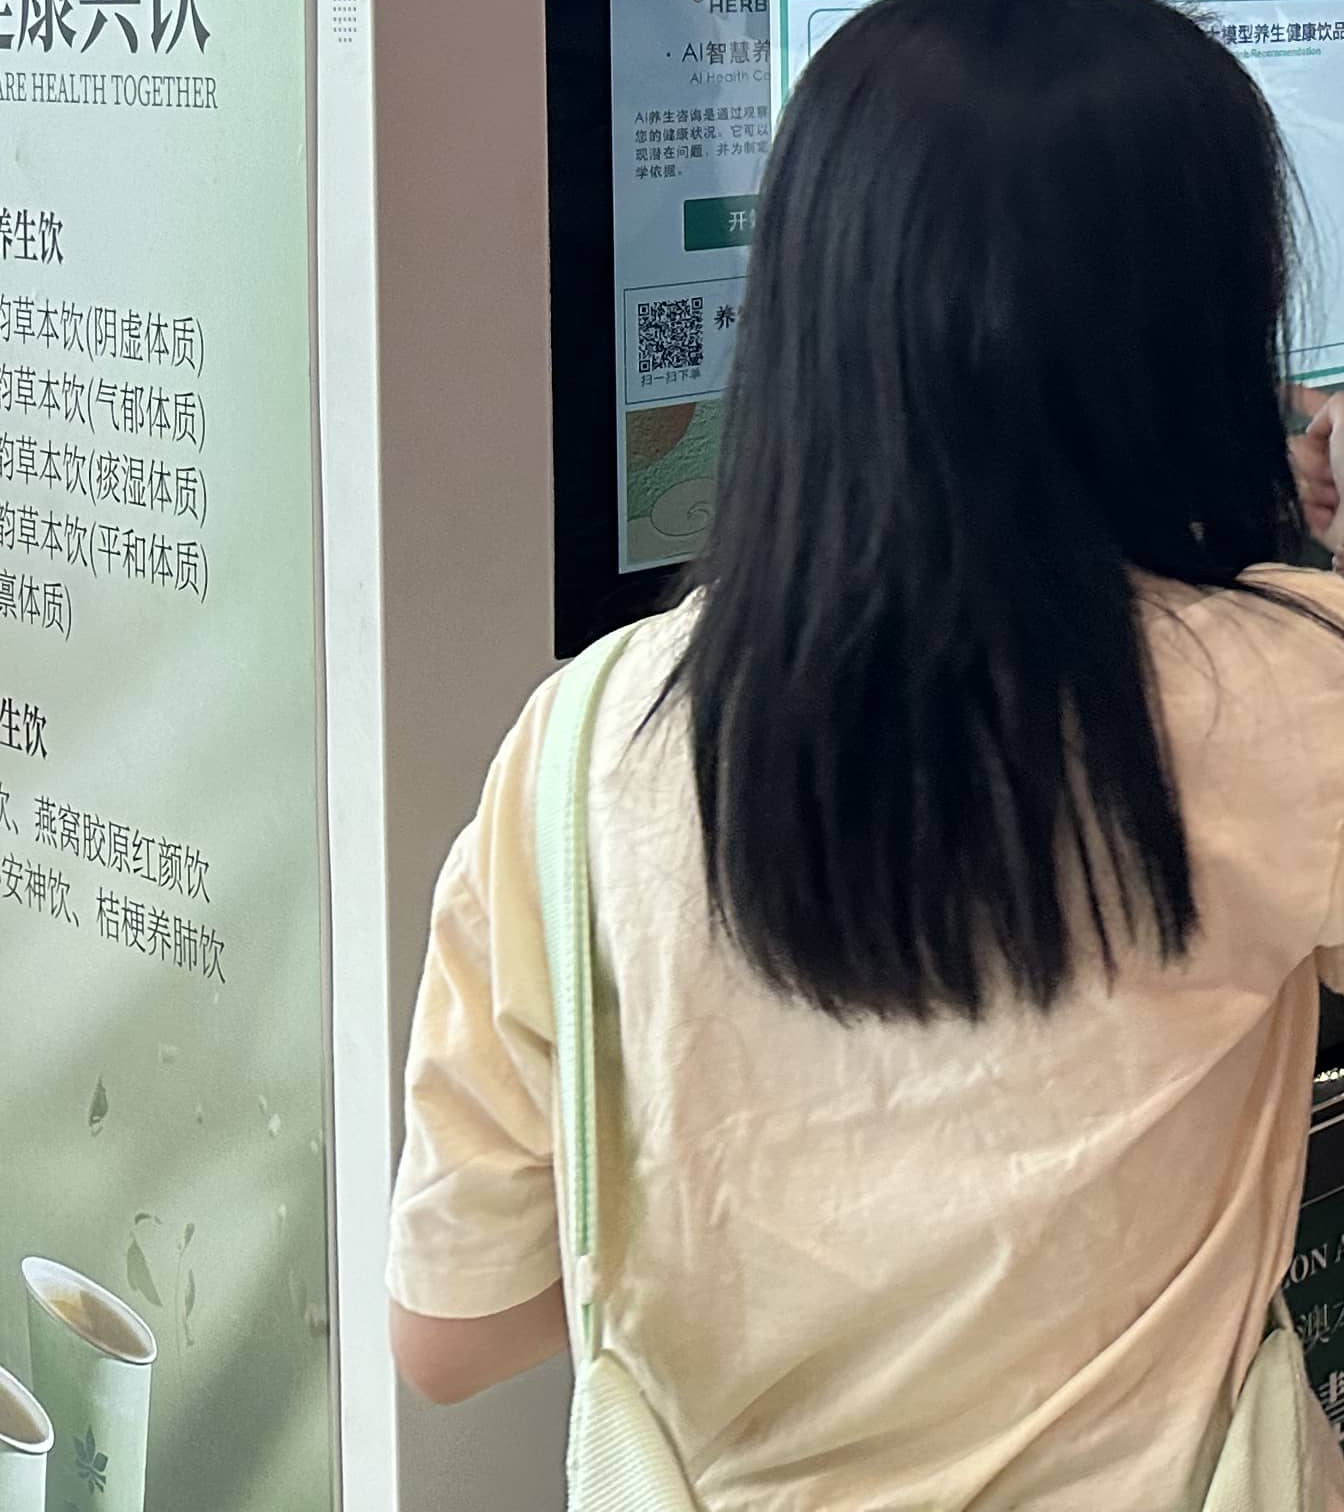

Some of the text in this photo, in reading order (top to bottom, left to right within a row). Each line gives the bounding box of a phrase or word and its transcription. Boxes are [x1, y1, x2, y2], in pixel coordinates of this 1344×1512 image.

[681, 40, 770, 65] AI智慧养
[32, 73, 106, 105] HEALTH
[111, 73, 219, 109] TOGETHER
[689, 72, 703, 85] AI
[707, 70, 750, 83] Health
[640, 365, 701, 388] 扫一扫下单
[1, 852, 226, 985] 安神饮、桔梗养肺饮
[1285, 1242, 1329, 1289] ON
